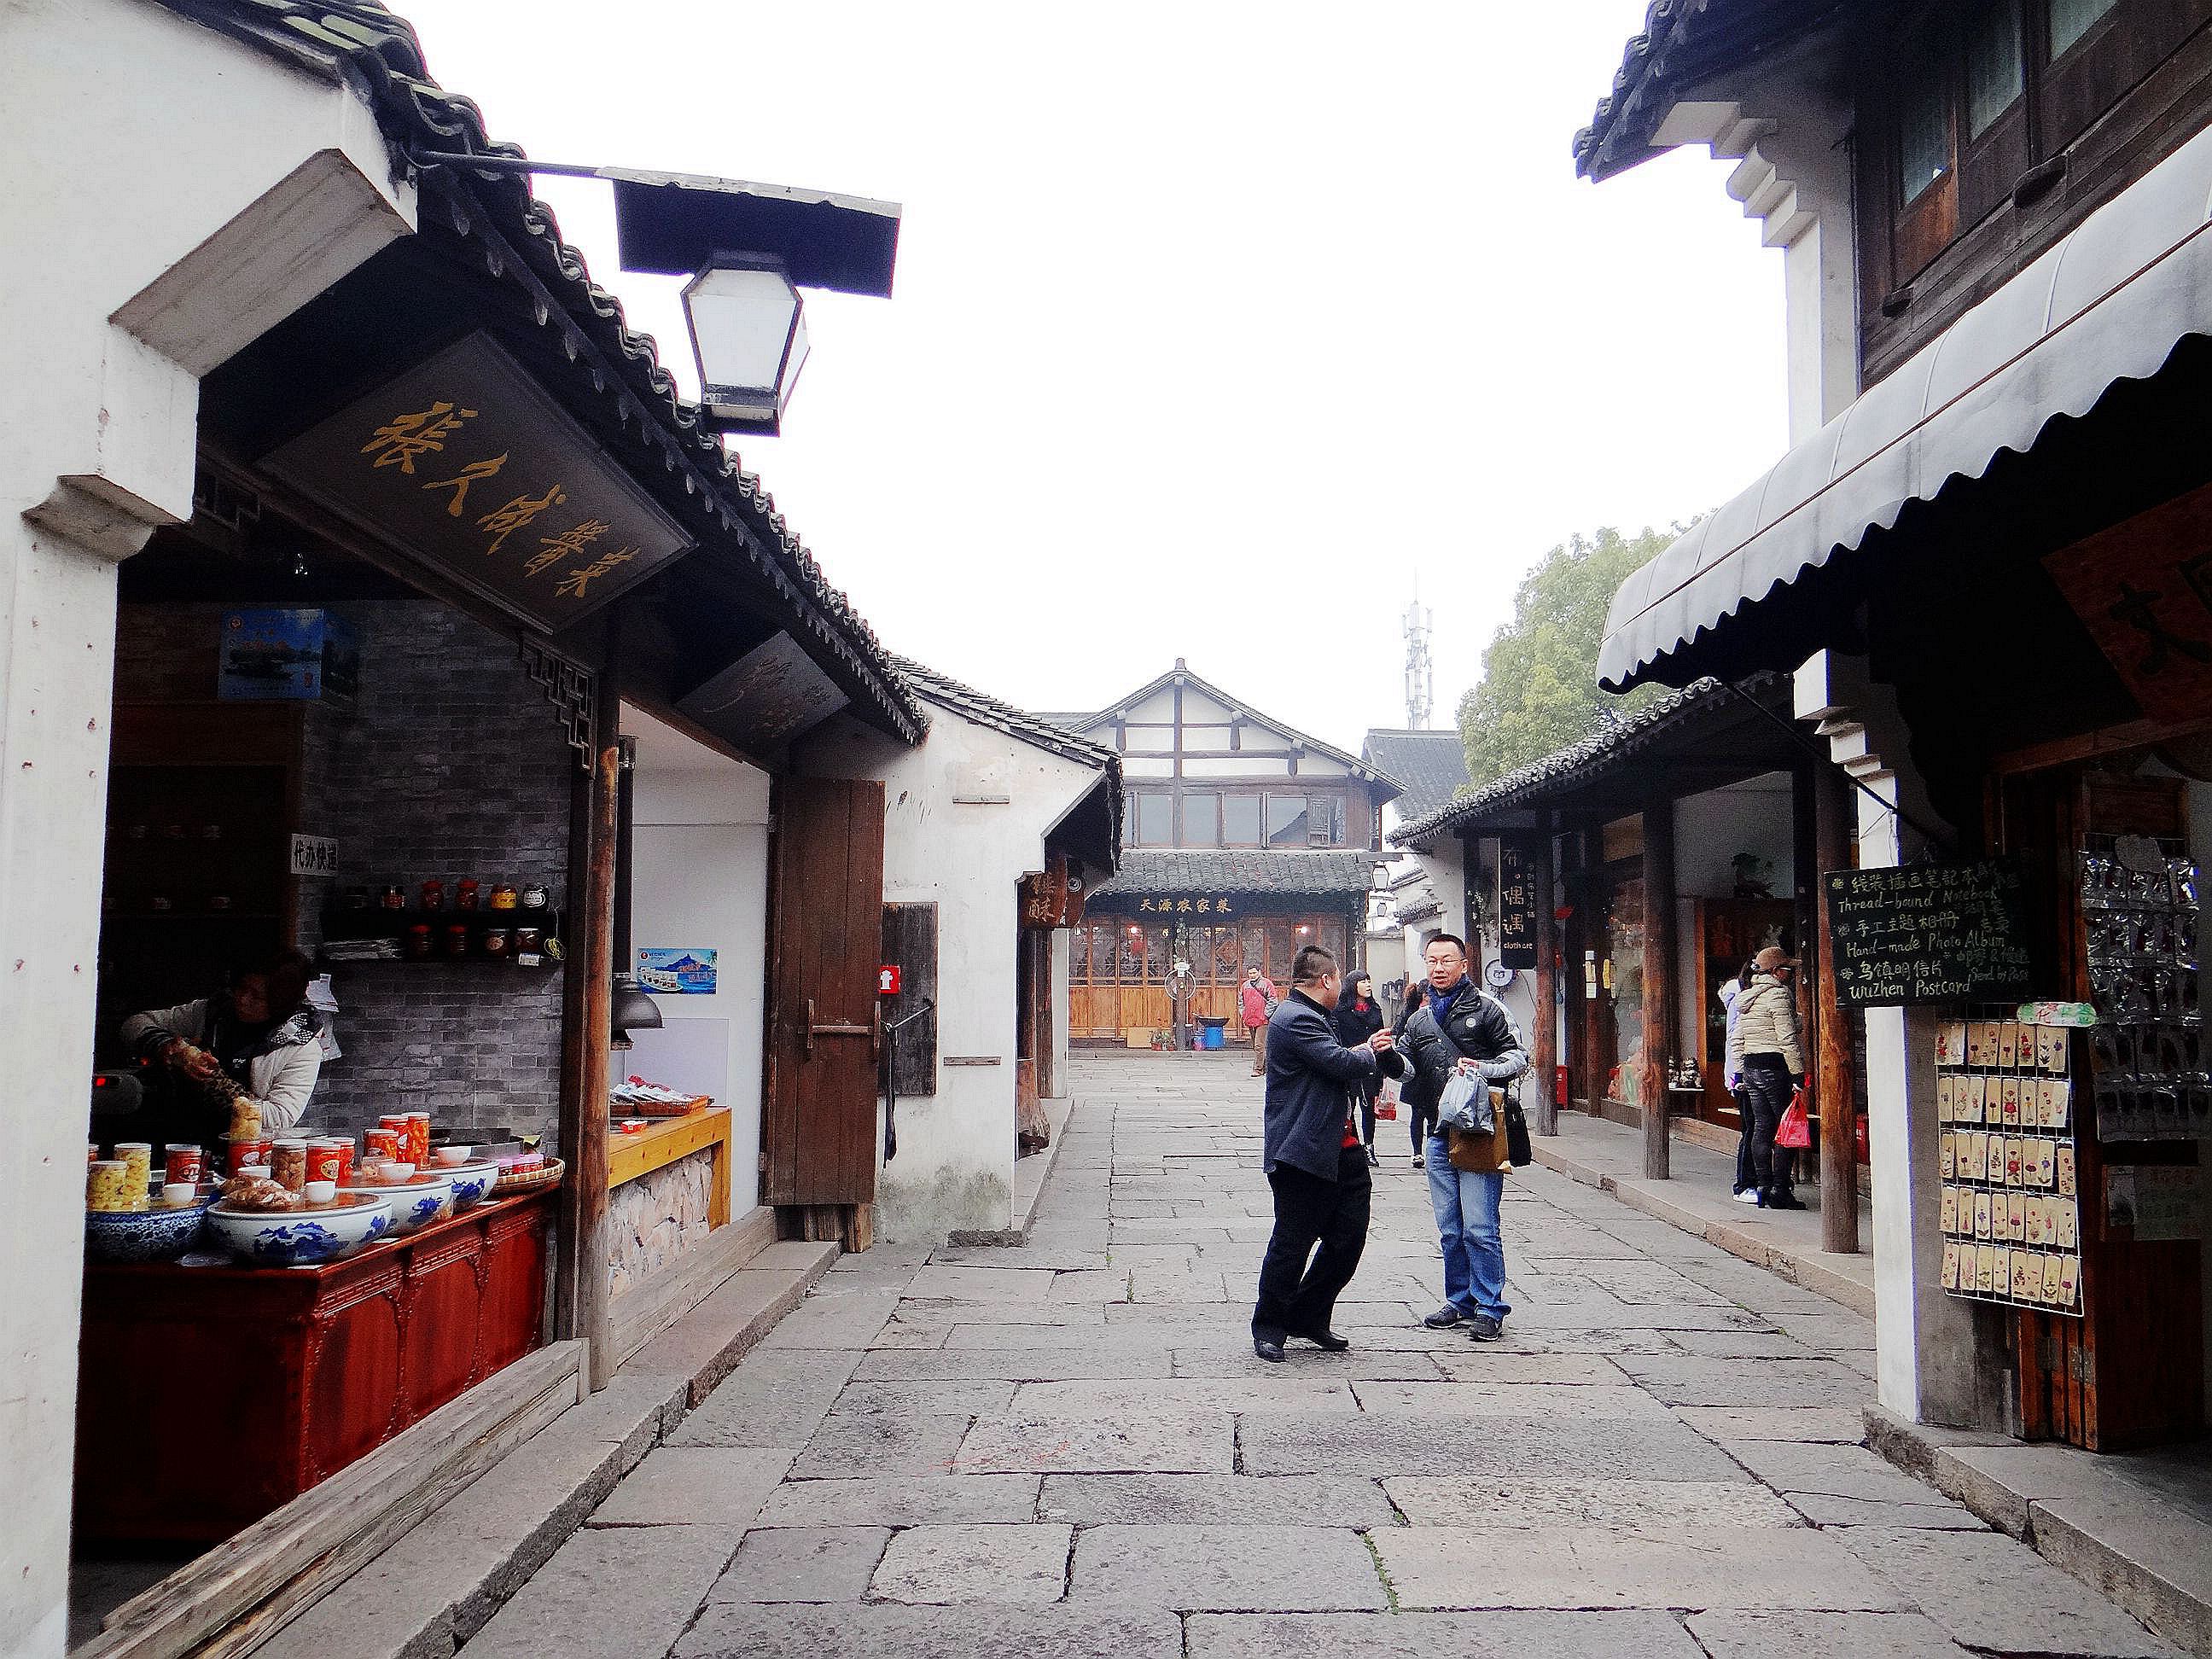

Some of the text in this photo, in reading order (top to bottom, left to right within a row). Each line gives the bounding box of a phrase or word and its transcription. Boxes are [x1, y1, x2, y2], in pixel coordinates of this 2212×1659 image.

[1838, 890, 1933, 913] Thread-bound
[1928, 933, 1961, 952] Photo
[1965, 928, 2005, 948] Album
